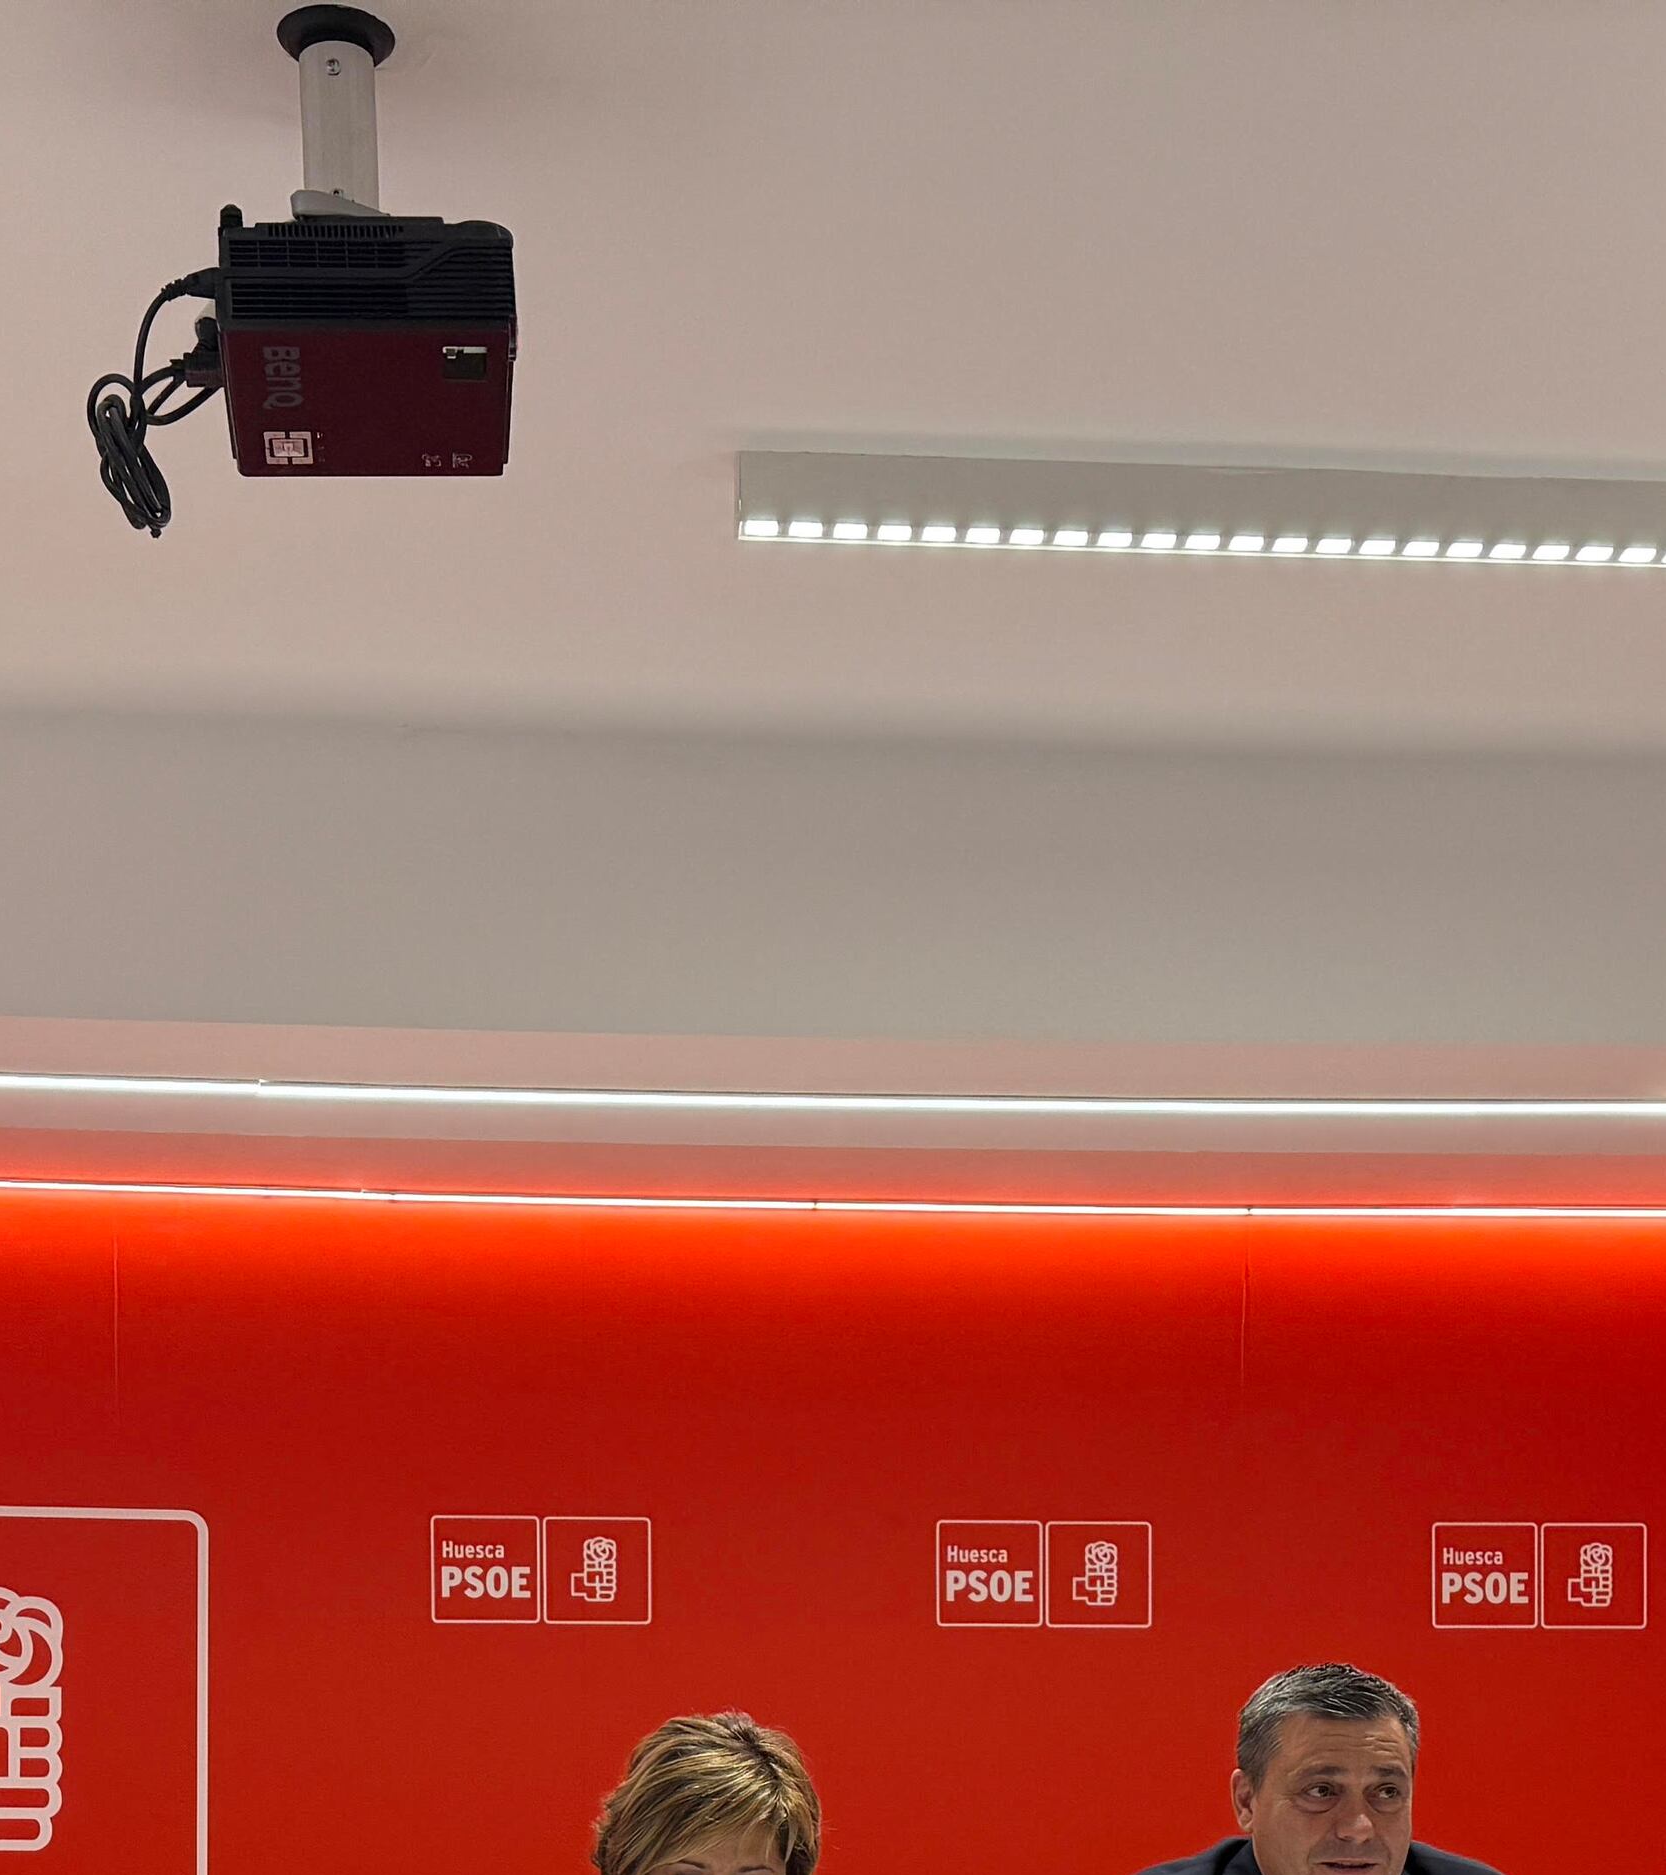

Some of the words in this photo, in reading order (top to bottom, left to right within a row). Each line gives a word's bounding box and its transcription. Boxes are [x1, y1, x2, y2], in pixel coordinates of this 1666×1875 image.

[262, 346, 304, 410] BenQ
[442, 1540, 505, 1559] Huesca
[947, 1545, 1009, 1563] Huesca
[1443, 1547, 1504, 1565] Huesca
[441, 1565, 531, 1599] PSOE
[946, 1570, 1034, 1603] PSOE
[1441, 1572, 1529, 1604] PSOE
